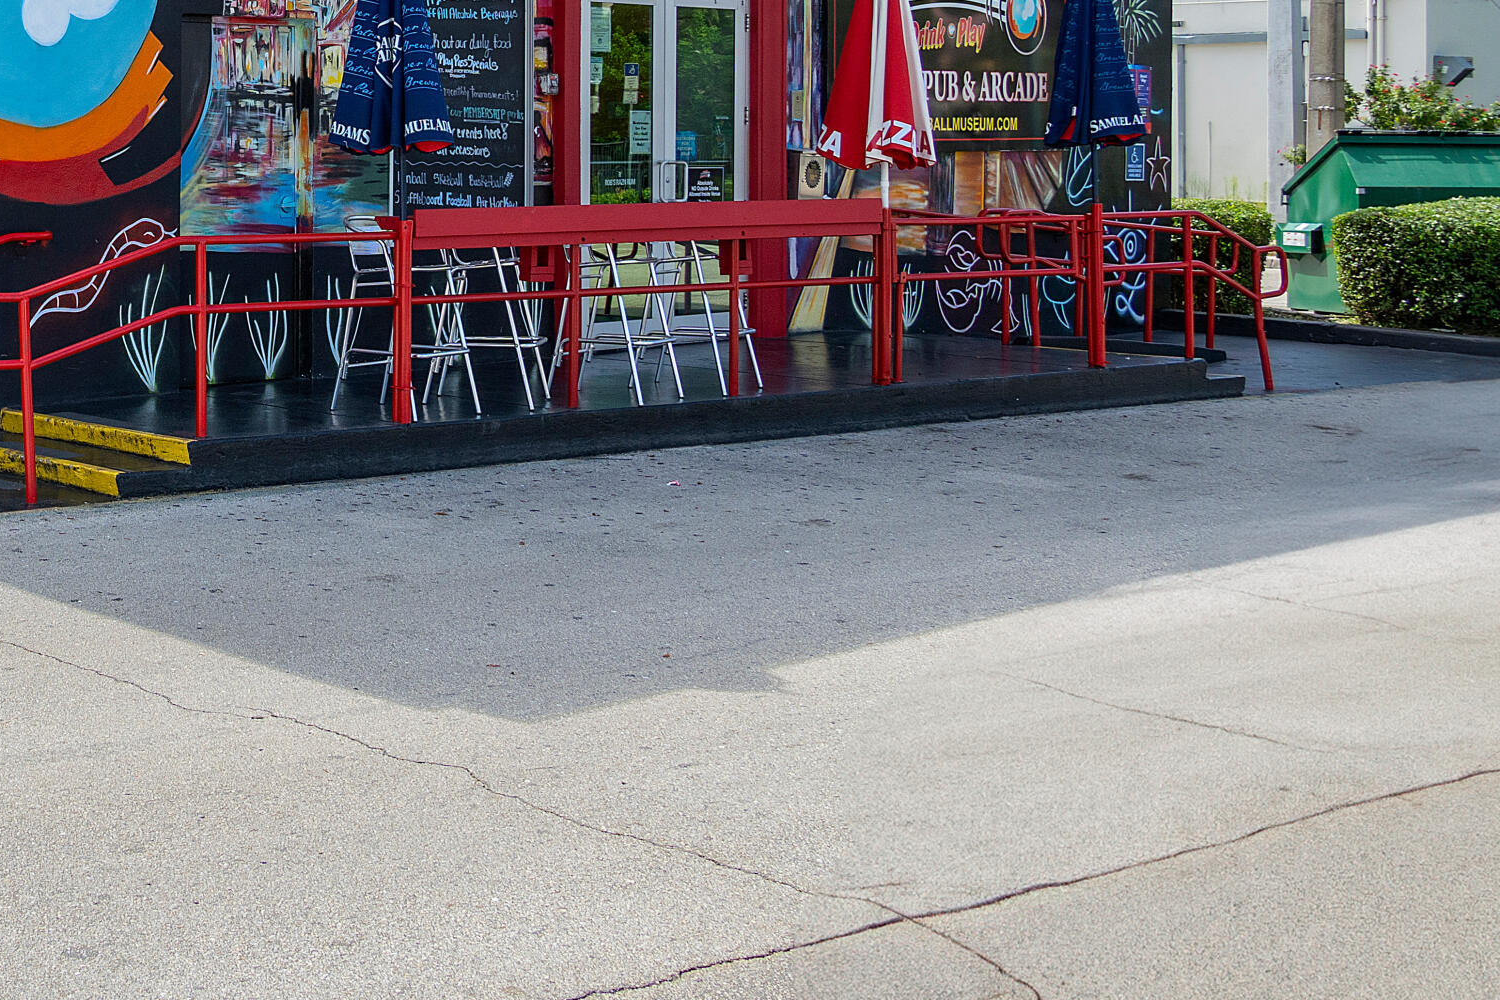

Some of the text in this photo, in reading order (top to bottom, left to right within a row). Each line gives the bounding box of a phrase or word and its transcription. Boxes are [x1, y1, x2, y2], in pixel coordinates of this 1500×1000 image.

[956, 15, 986, 53] Play
[469, 32, 493, 59] daily
[494, 32, 512, 49] food
[346, 60, 374, 76] Patrio
[924, 70, 1049, 103] PUB & ARCADE
[463, 106, 506, 119] MEMBERSHIP
[330, 121, 371, 145] ADAMS
[404, 119, 436, 138] MUEL
[930, 116, 1018, 132] BALLMUSEUM.COM
[1090, 116, 1132, 134] SAMUEL
